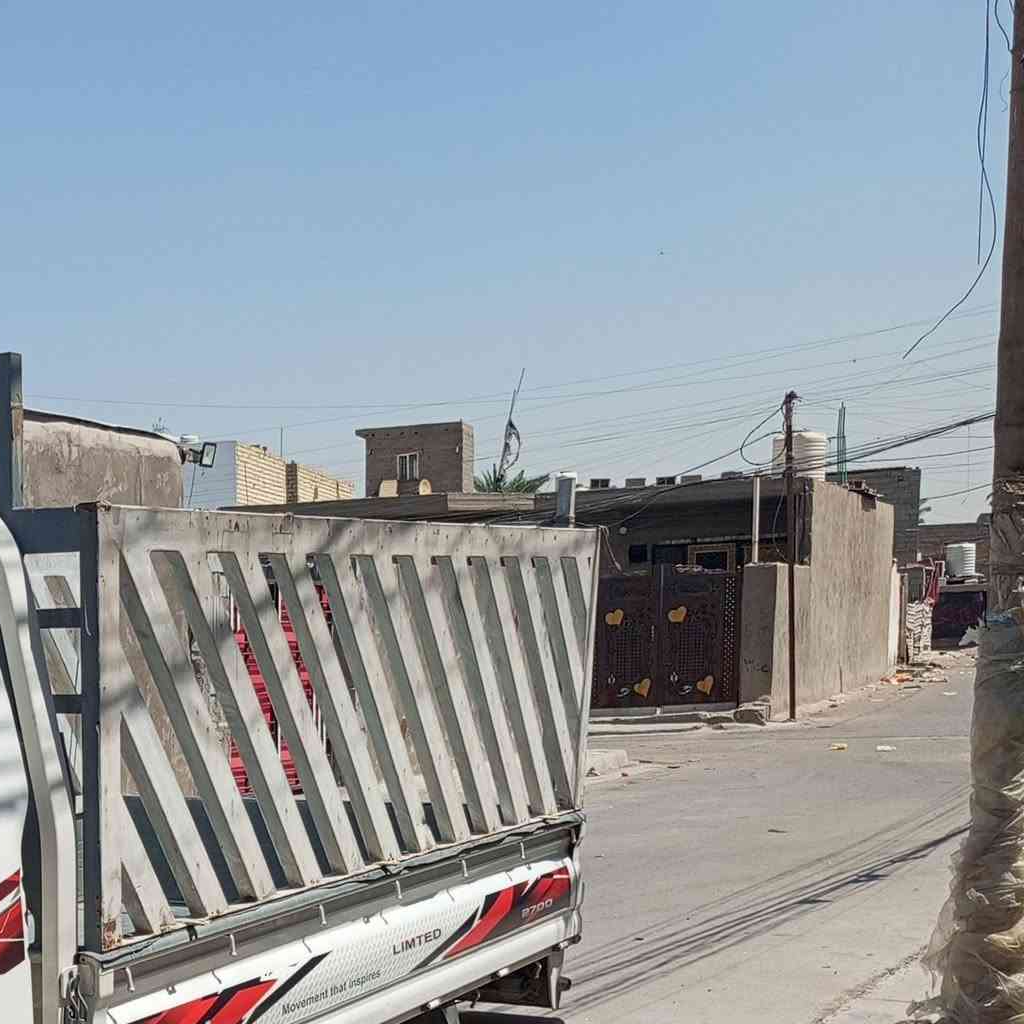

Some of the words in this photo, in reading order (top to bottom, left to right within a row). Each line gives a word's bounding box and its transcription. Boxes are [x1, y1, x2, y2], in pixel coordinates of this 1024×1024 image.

[392, 928, 442, 955] LIMTED
[281, 989, 329, 1016] Movement
[330, 982, 347, 997] that
[349, 969, 381, 988] inspires
